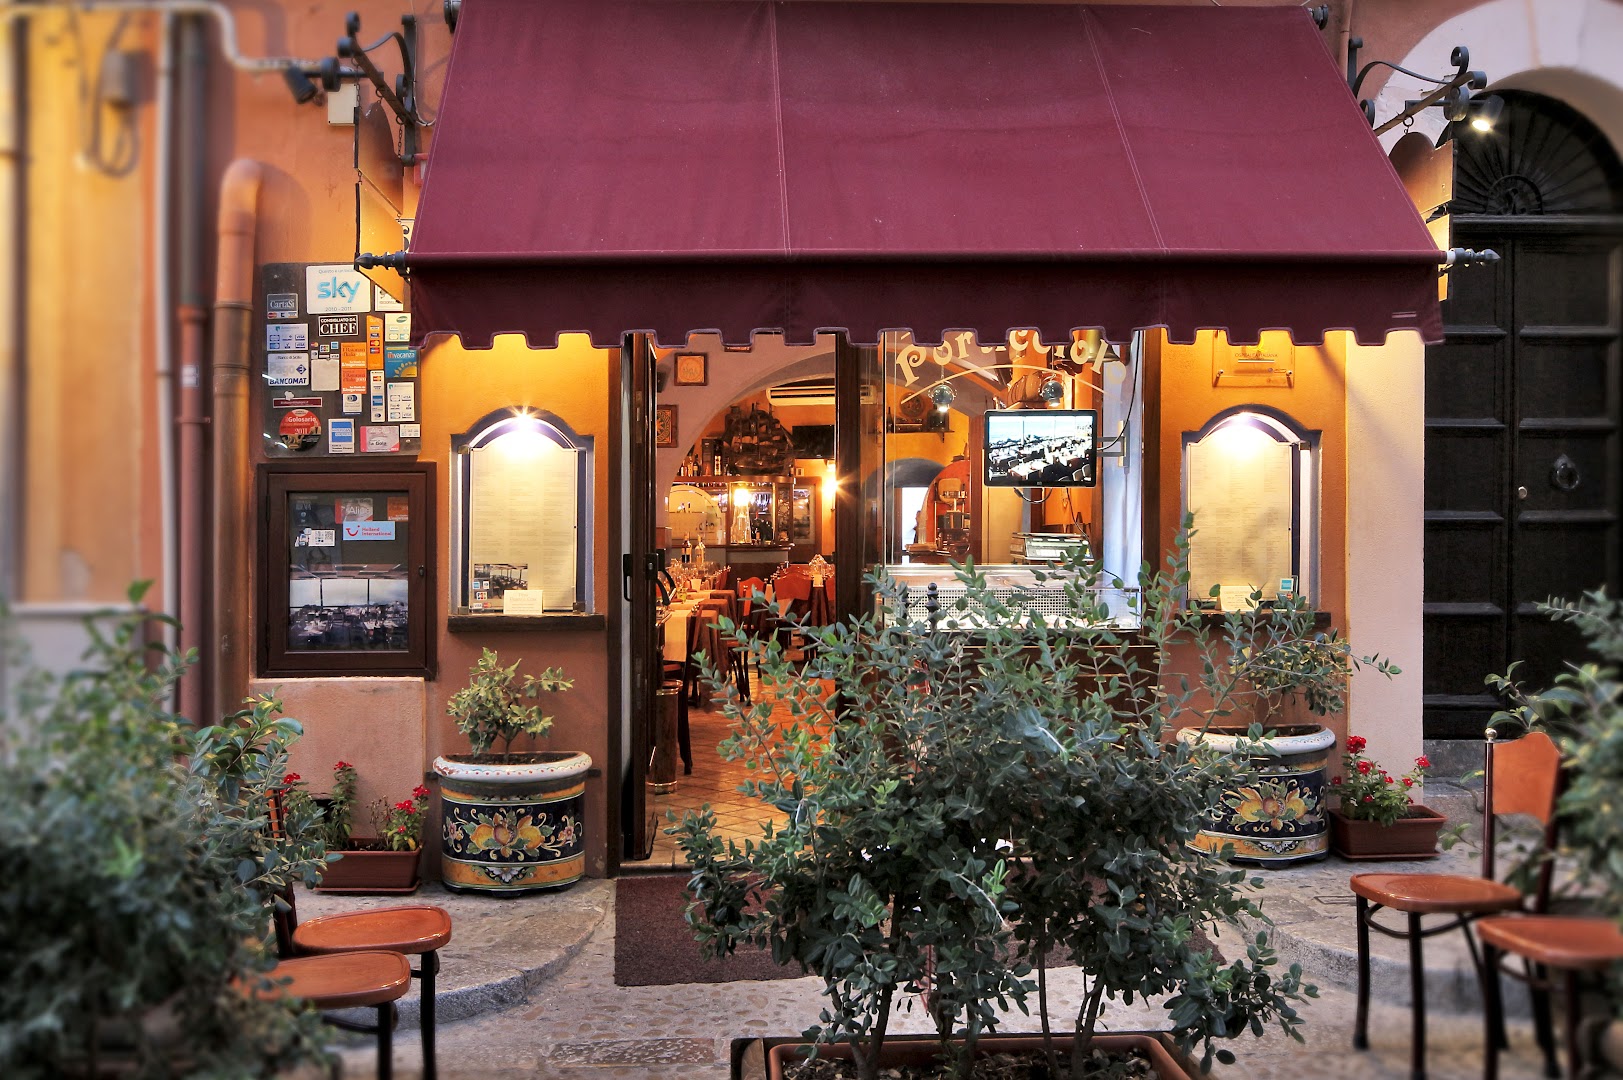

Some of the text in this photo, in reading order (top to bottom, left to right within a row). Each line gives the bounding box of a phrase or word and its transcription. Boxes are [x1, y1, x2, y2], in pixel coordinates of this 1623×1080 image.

[317, 276, 360, 303] sky
[320, 323, 357, 334] CHEF
[269, 377, 307, 385] BANCOMAT
